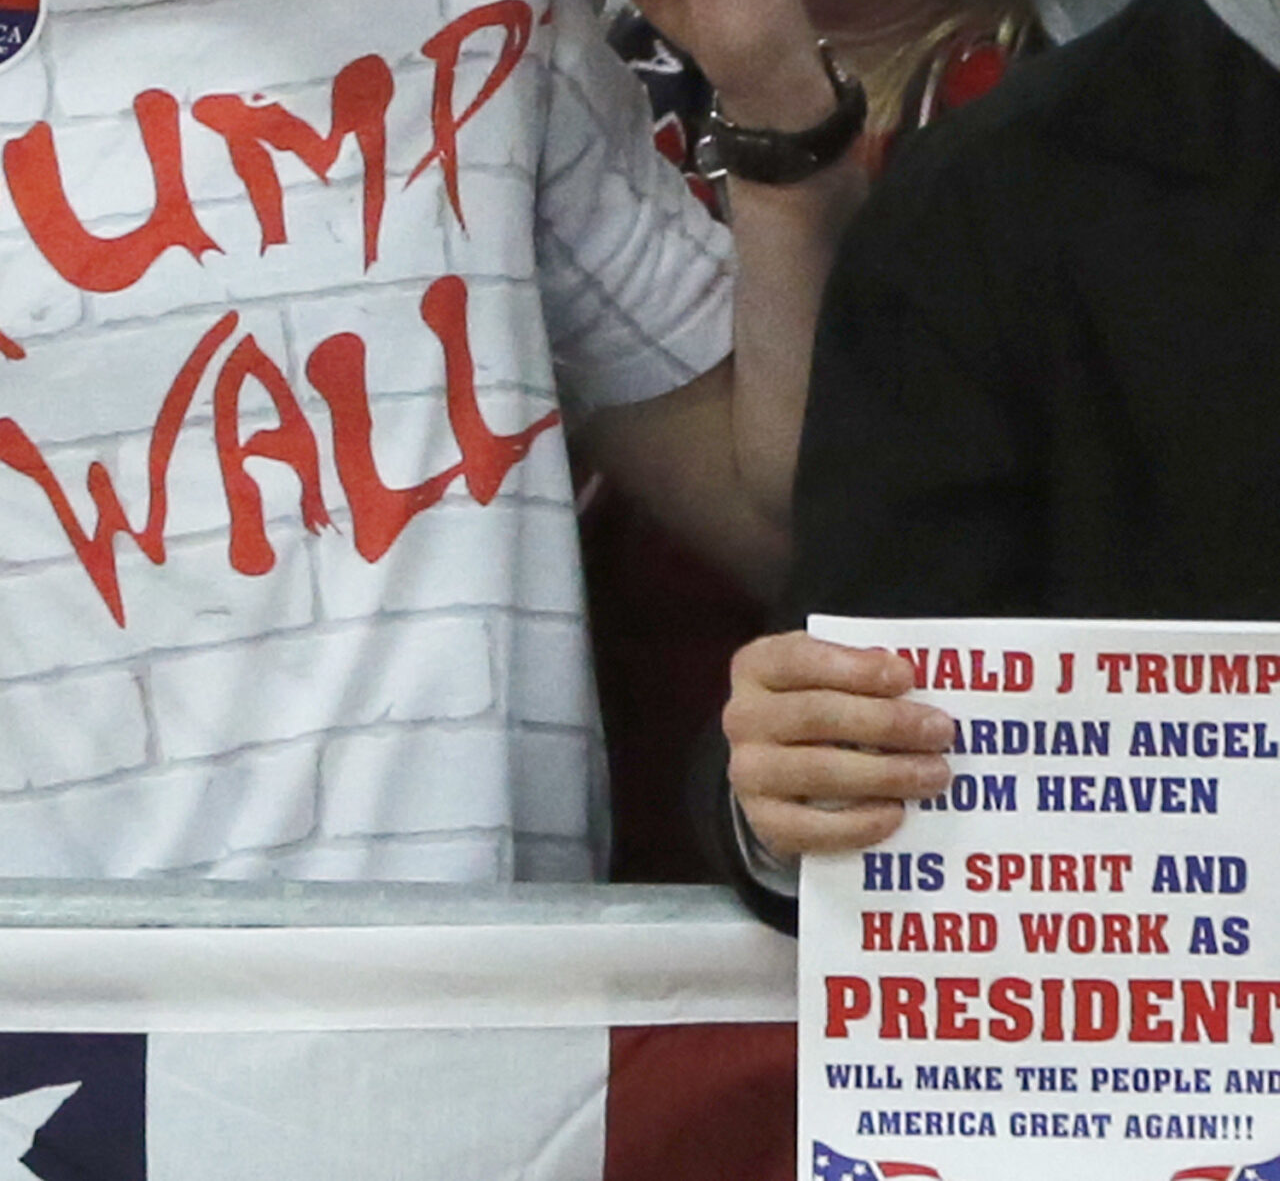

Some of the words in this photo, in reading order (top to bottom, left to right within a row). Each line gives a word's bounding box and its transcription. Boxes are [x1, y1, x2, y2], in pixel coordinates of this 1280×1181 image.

[897, 647, 1034, 692] NALD
[1057, 652, 1075, 694] J
[1097, 652, 1280, 694] TRUMP
[946, 718, 1110, 756] RDIAN
[1130, 721, 1279, 758] ANGEL
[919, 774, 1018, 812] OM
[1037, 776, 1219, 814] HEAVEN
[863, 853, 945, 892] HIS
[965, 853, 1132, 893] SPIRIT
[1152, 855, 1247, 894] AND
[861, 911, 999, 953] HARD
[1020, 912, 1170, 955] WORK
[1189, 916, 1250, 956] AS
[824, 975, 1280, 1044] PRESIDENT
[825, 1064, 903, 1089] WILL
[916, 1065, 1003, 1091] MAKE
[1016, 1067, 1078, 1092] THE
[1091, 1068, 1212, 1093] PEOPLE
[1225, 1069, 1280, 1093] AND
[857, 1110, 996, 1137] AMERICA
[1009, 1112, 1112, 1138] GREAT
[1124, 1114, 1254, 1140] AGAIN!!!
